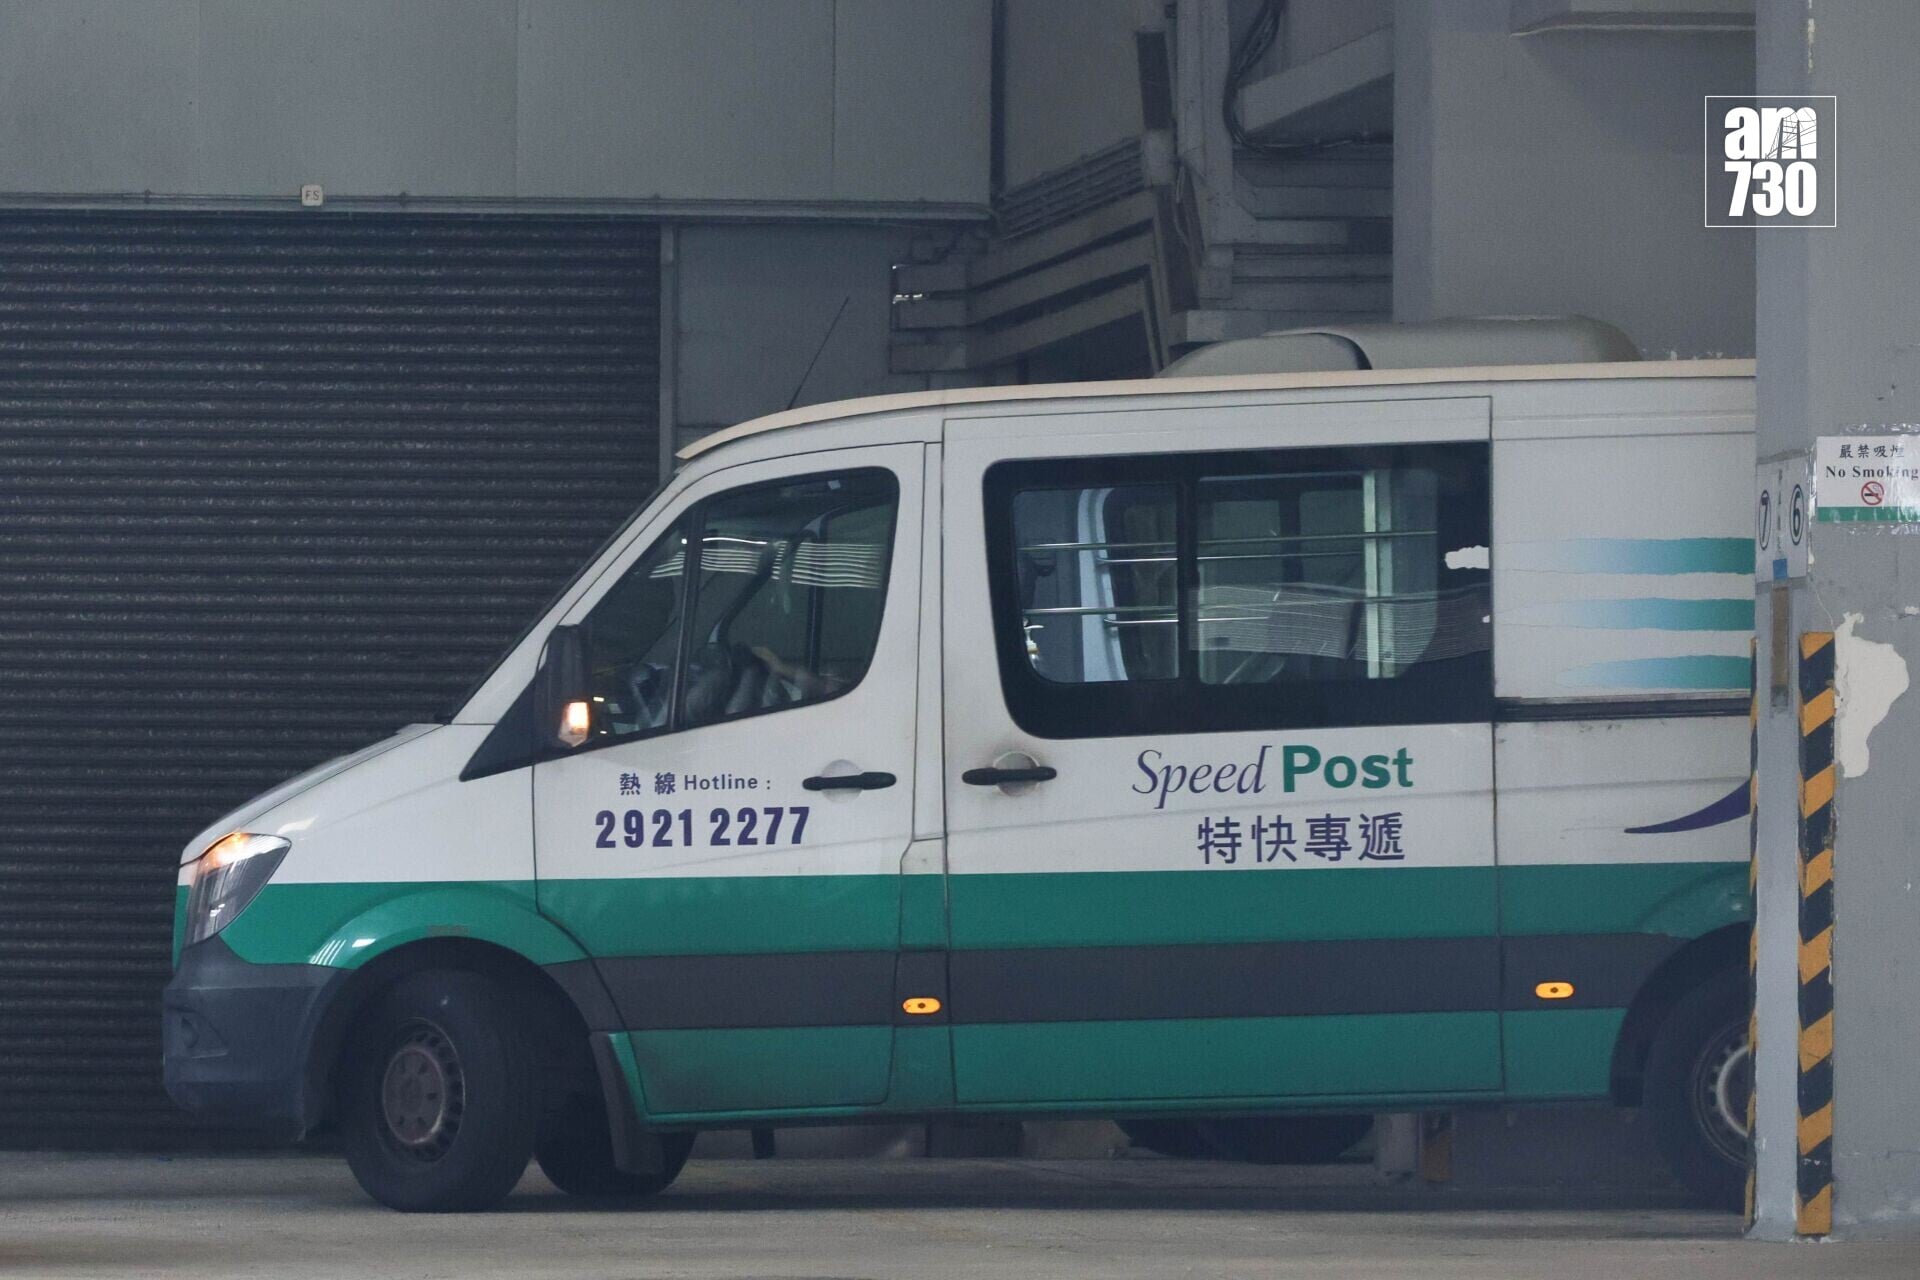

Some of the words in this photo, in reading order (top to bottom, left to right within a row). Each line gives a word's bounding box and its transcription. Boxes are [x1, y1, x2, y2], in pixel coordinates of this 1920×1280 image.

[1825, 465, 1846, 479] No
[1852, 465, 1919, 481] Smoking
[1760, 496, 1770, 543] 7
[1793, 490, 1801, 538] 6
[1132, 745, 1273, 810] Speed
[1282, 744, 1414, 793] Post
[595, 808, 693, 849] 2921
[709, 806, 810, 847] 2277
[1196, 811, 1406, 865] 特快專遞
